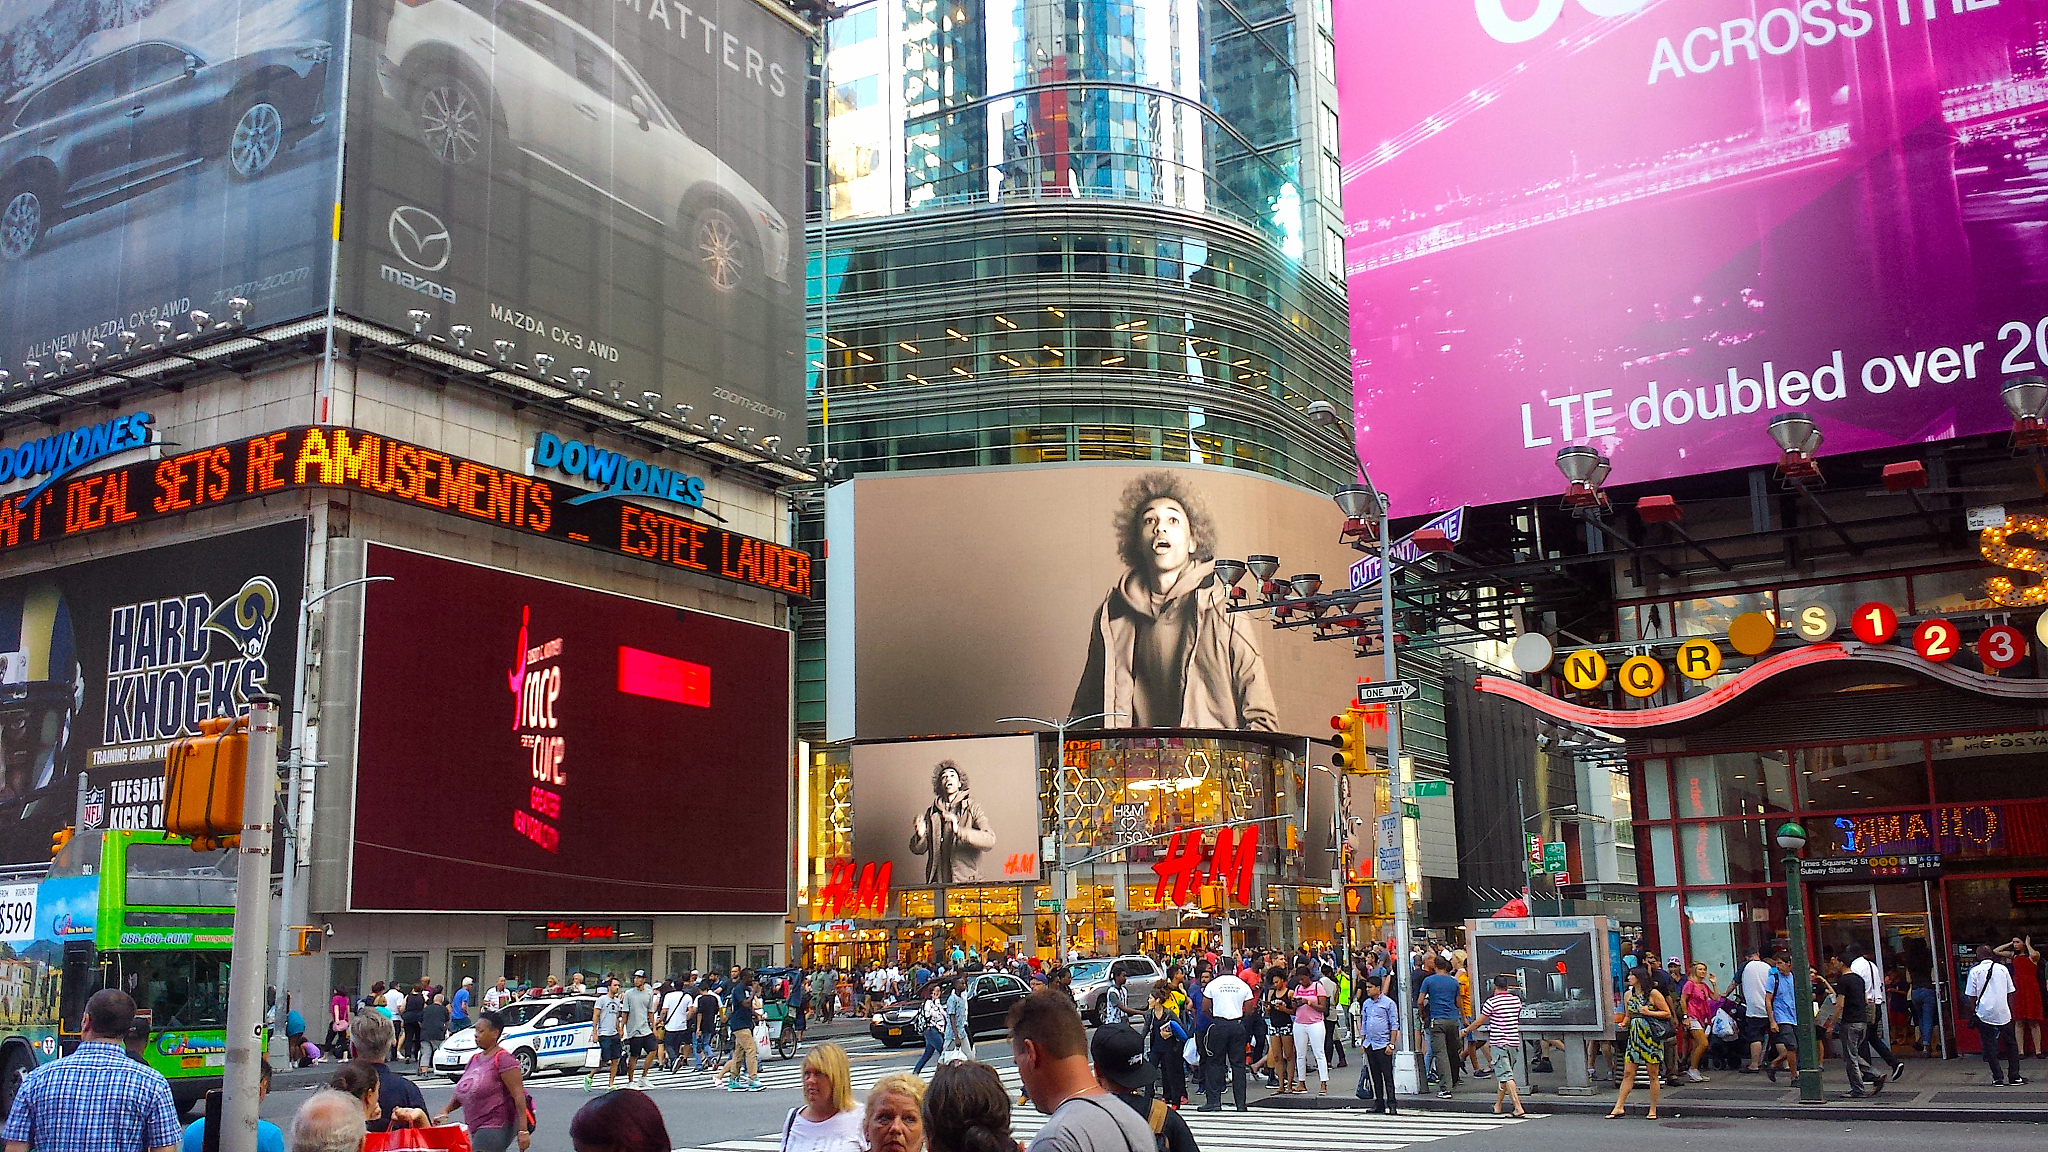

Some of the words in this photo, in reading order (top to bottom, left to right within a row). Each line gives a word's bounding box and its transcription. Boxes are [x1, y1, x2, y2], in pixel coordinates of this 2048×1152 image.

[1648, 0, 1873, 84] ACROSS
[210, 266, 310, 305] zoom-zoom
[27, 331, 78, 359] ALL-NEW
[81, 316, 125, 345] MAZDA
[129, 307, 158, 328] CX-9
[162, 297, 190, 319] AWD
[490, 303, 545, 338] MAZDA
[551, 326, 584, 350] CX-3
[587, 339, 619, 362] AWD
[713, 385, 787, 422] zoom-zoom
[1522, 388, 1617, 450] LTE
[1627, 351, 1847, 432] doubled
[1860, 340, 1985, 395] over
[65, 470, 137, 534] DEAL
[153, 446, 231, 513] SETS
[293, 428, 552, 532] AMUSEMENTS
[620, 505, 708, 571] ESTEE
[721, 532, 811, 596] LAUDER
[1980, 514, 2048, 608] S
[108, 593, 213, 676] HARD
[1573, 655, 1597, 683] N
[1628, 663, 1655, 690] Q
[1688, 646, 1712, 672] R
[1801, 606, 1827, 637] S
[1865, 608, 1884, 637] 1
[1924, 626, 1948, 655] 2
[1989, 631, 2014, 662] 3
[103, 657, 268, 746] KNOCKS
[522, 665, 561, 729] race
[1366, 689, 1384, 698] ONE
[1391, 686, 1410, 695] WAY
[93, 748, 129, 765] TRAINING
[130, 746, 153, 761] CAMP
[533, 735, 567, 786] cure
[85, 805, 100, 823] NFL
[1114, 804, 1144, 816] H&M
[1418, 782, 1427, 796] 7
[110, 804, 148, 830] KICKS
[1152, 824, 1259, 907] H&M
[1531, 836, 1540, 861] ART
[1828, 866, 1853, 874] Station
[820, 861, 892, 916] H&M
[1554, 920, 1577, 928] TITAN
[543, 1033, 575, 1050] NYPD
